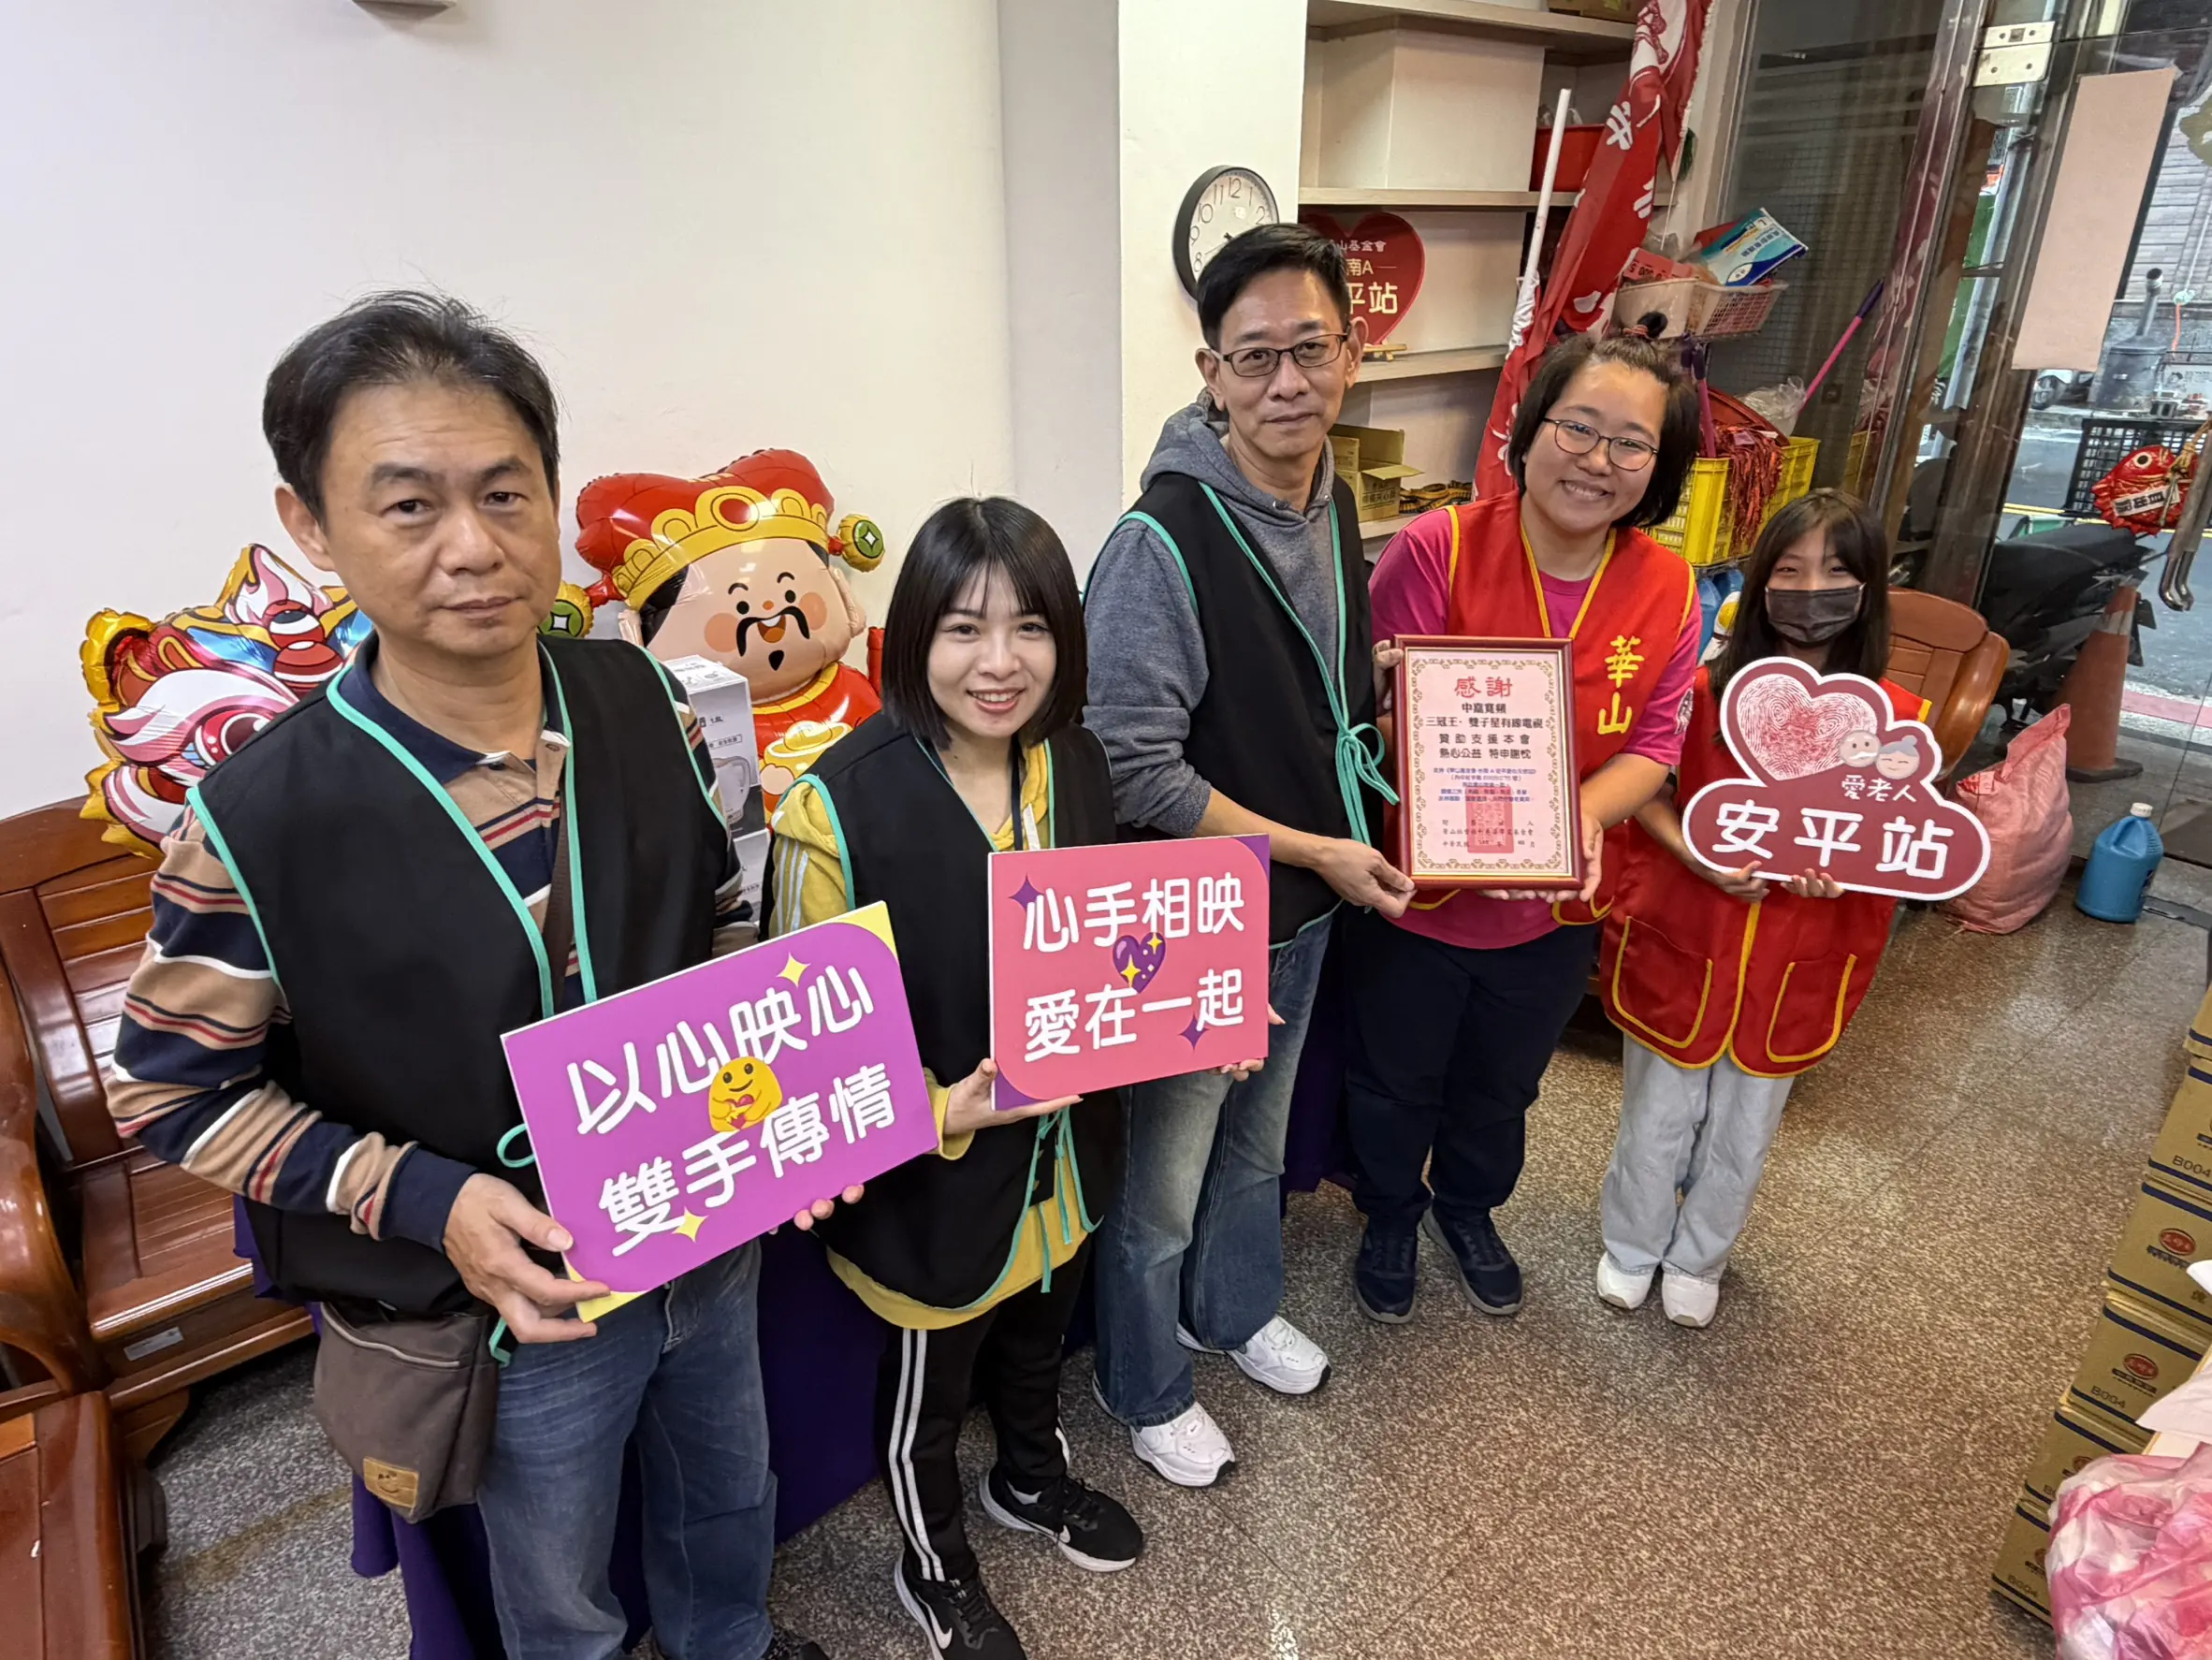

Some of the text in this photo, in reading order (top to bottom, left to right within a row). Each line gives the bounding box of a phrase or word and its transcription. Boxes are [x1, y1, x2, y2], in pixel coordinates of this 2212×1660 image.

[1214, 183, 1224, 205] 11
[1229, 176, 1242, 198] 12
[1198, 203, 1214, 224] 10
[1255, 205, 1267, 225] 2
[1189, 226, 1201, 246] 9
[1193, 252, 1203, 272] 8
[1454, 676, 1513, 698] 感謝
[1596, 634, 1645, 735] 華山
[1841, 775, 1917, 803] 愛老人
[1711, 799, 1955, 880] 安平站
[1023, 872, 1245, 953] 心手相映
[1025, 968, 1244, 1063] 愛在一起
[566, 965, 874, 1135] 以心映心
[598, 1063, 896, 1257] 雙手傳情
[2172, 1155, 2211, 1177] B004
[2090, 1386, 2126, 1408] B004
